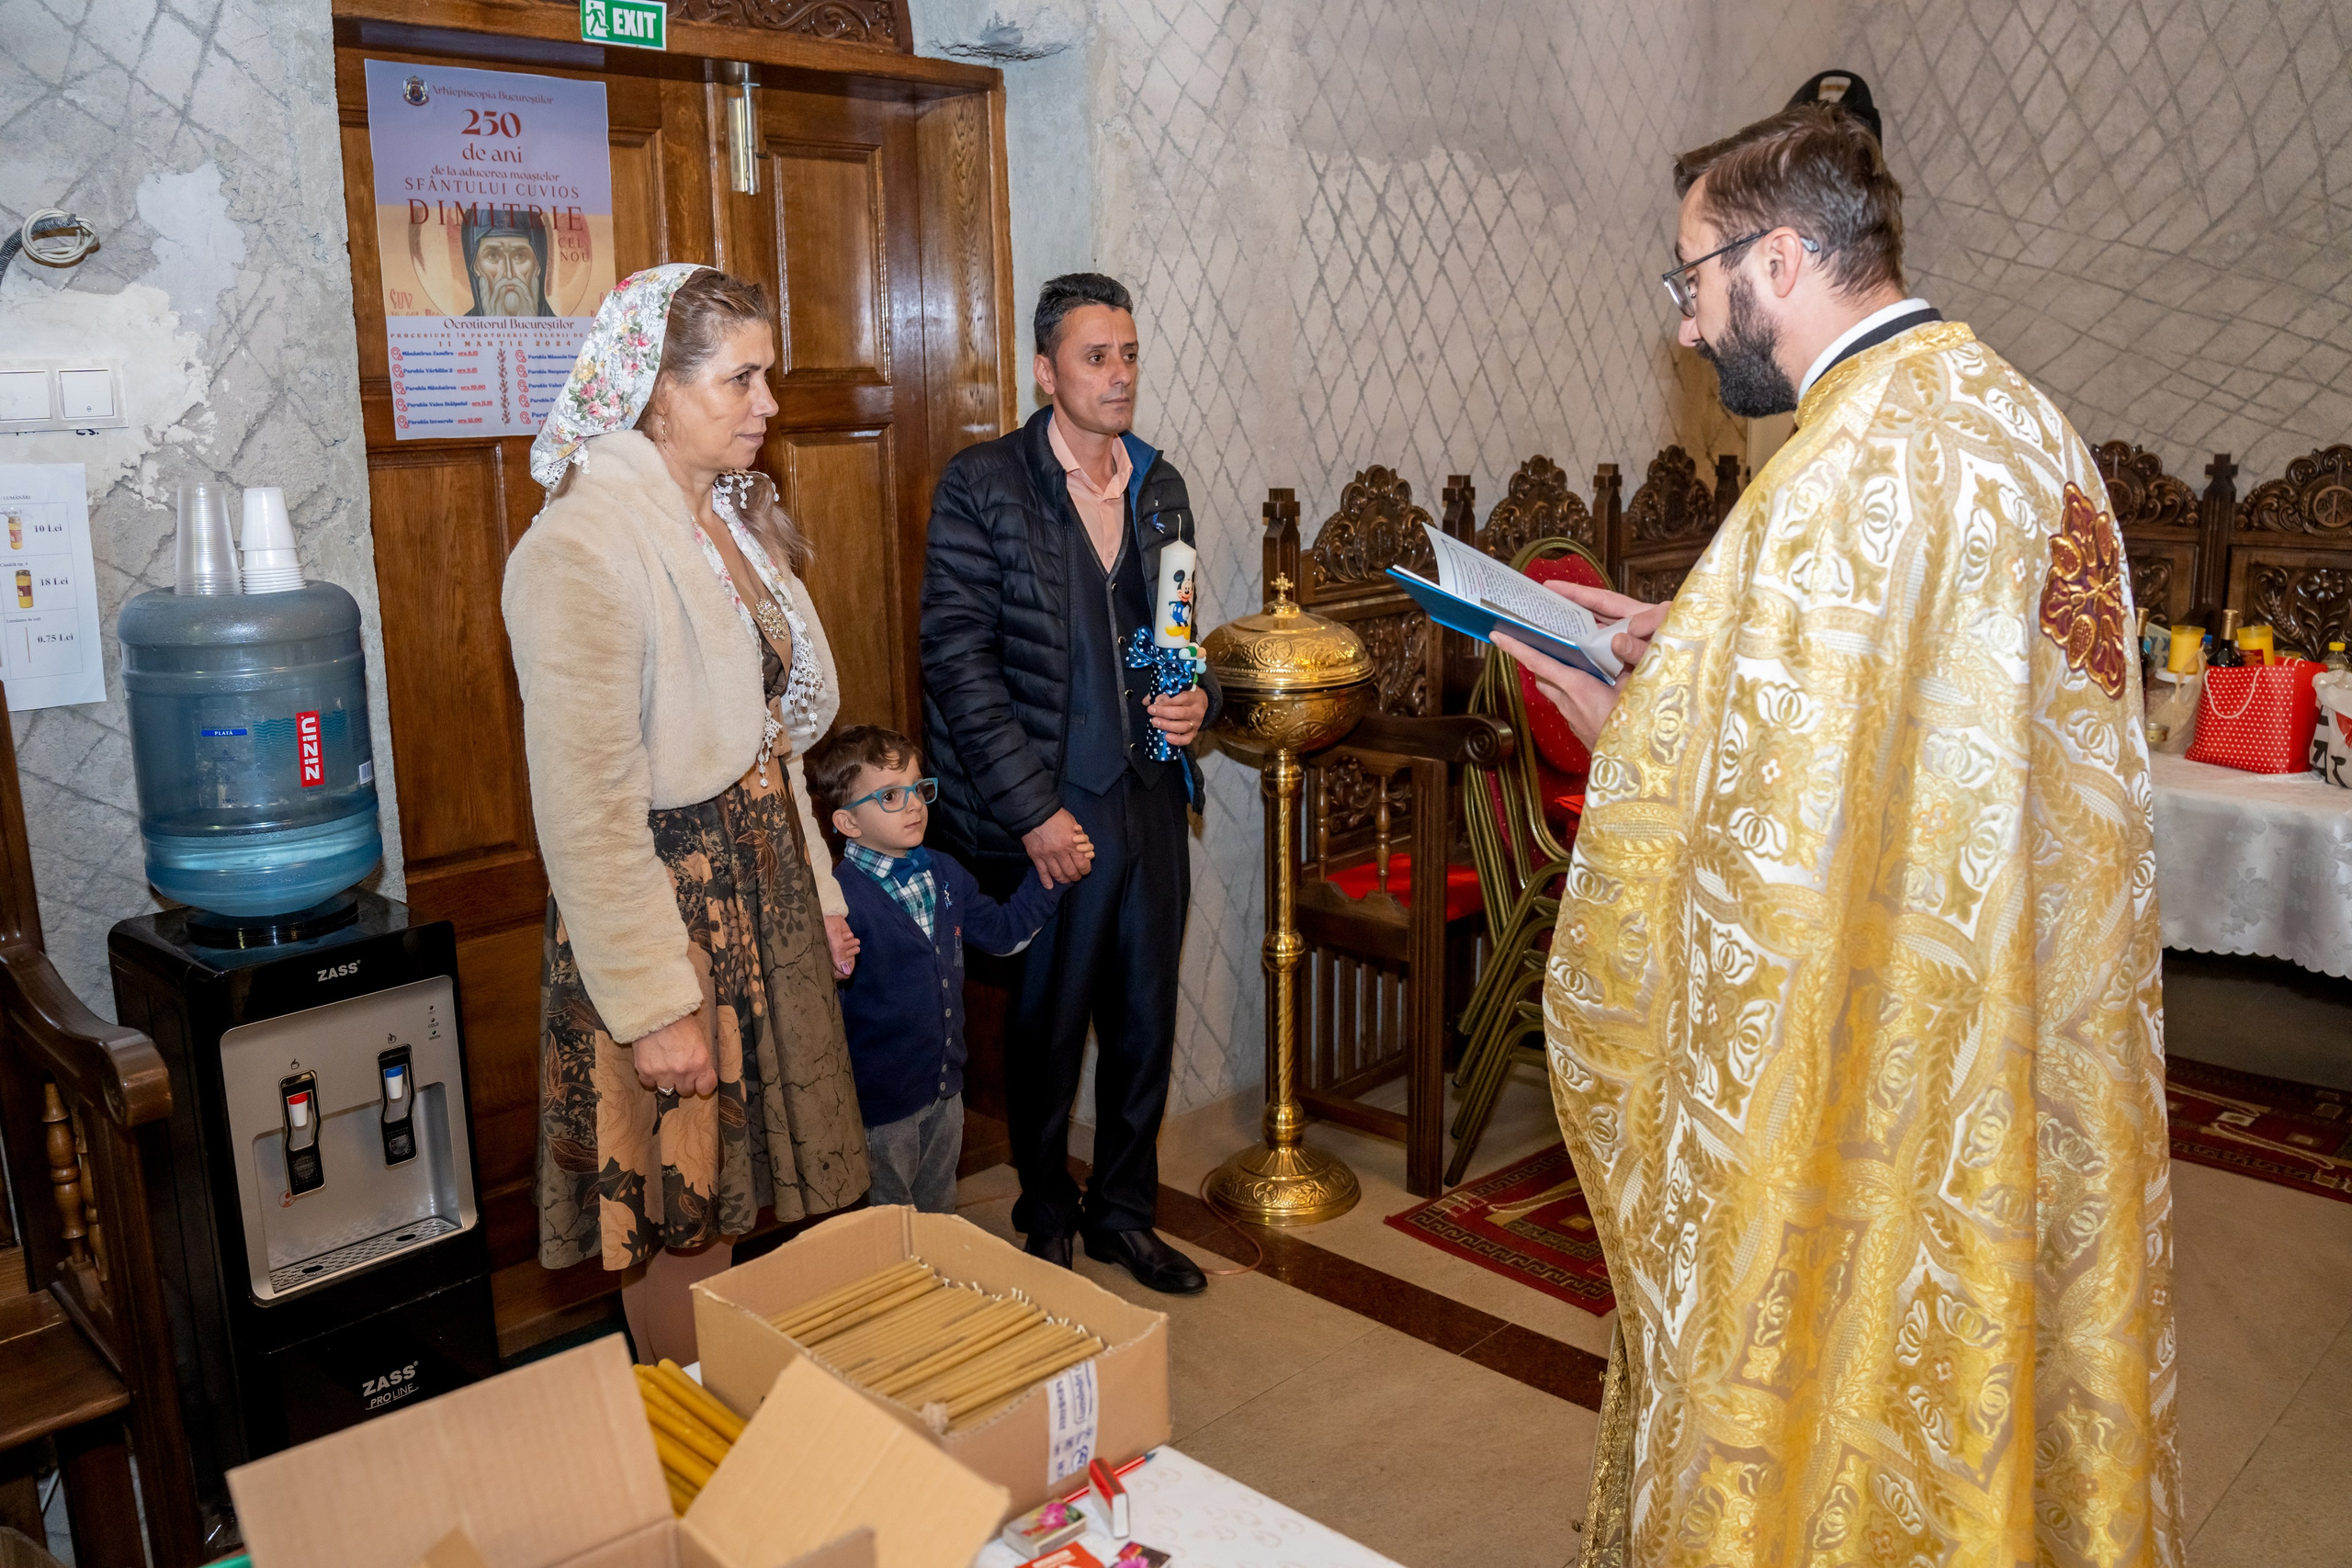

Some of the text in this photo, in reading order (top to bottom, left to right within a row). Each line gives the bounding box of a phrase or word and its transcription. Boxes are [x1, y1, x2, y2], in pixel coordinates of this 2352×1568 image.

[612, 7, 657, 39] EXIT
[432, 85, 554, 105] Arhiepiscopia Bucureștilor
[461, 108, 521, 139] 250
[462, 142, 523, 164] de ani
[431, 164, 560, 183] de la aducerea moaștelor
[404, 175, 580, 199] SFÂNTULUI CUVIOS
[406, 197, 584, 231] DIMITRIE
[558, 237, 583, 249] CEL
[560, 251, 591, 263] NOU
[443, 318, 575, 331] Ocrotitorul Bucureștilor
[34, 524, 63, 533] 10 Lei
[40, 577, 69, 587] 18 Lei
[37, 633, 74, 644] 0.75 Lei
[316, 962, 359, 982] ZASS
[362, 1364, 417, 1397] ZASS
[370, 1382, 414, 1408] PRO LINE
